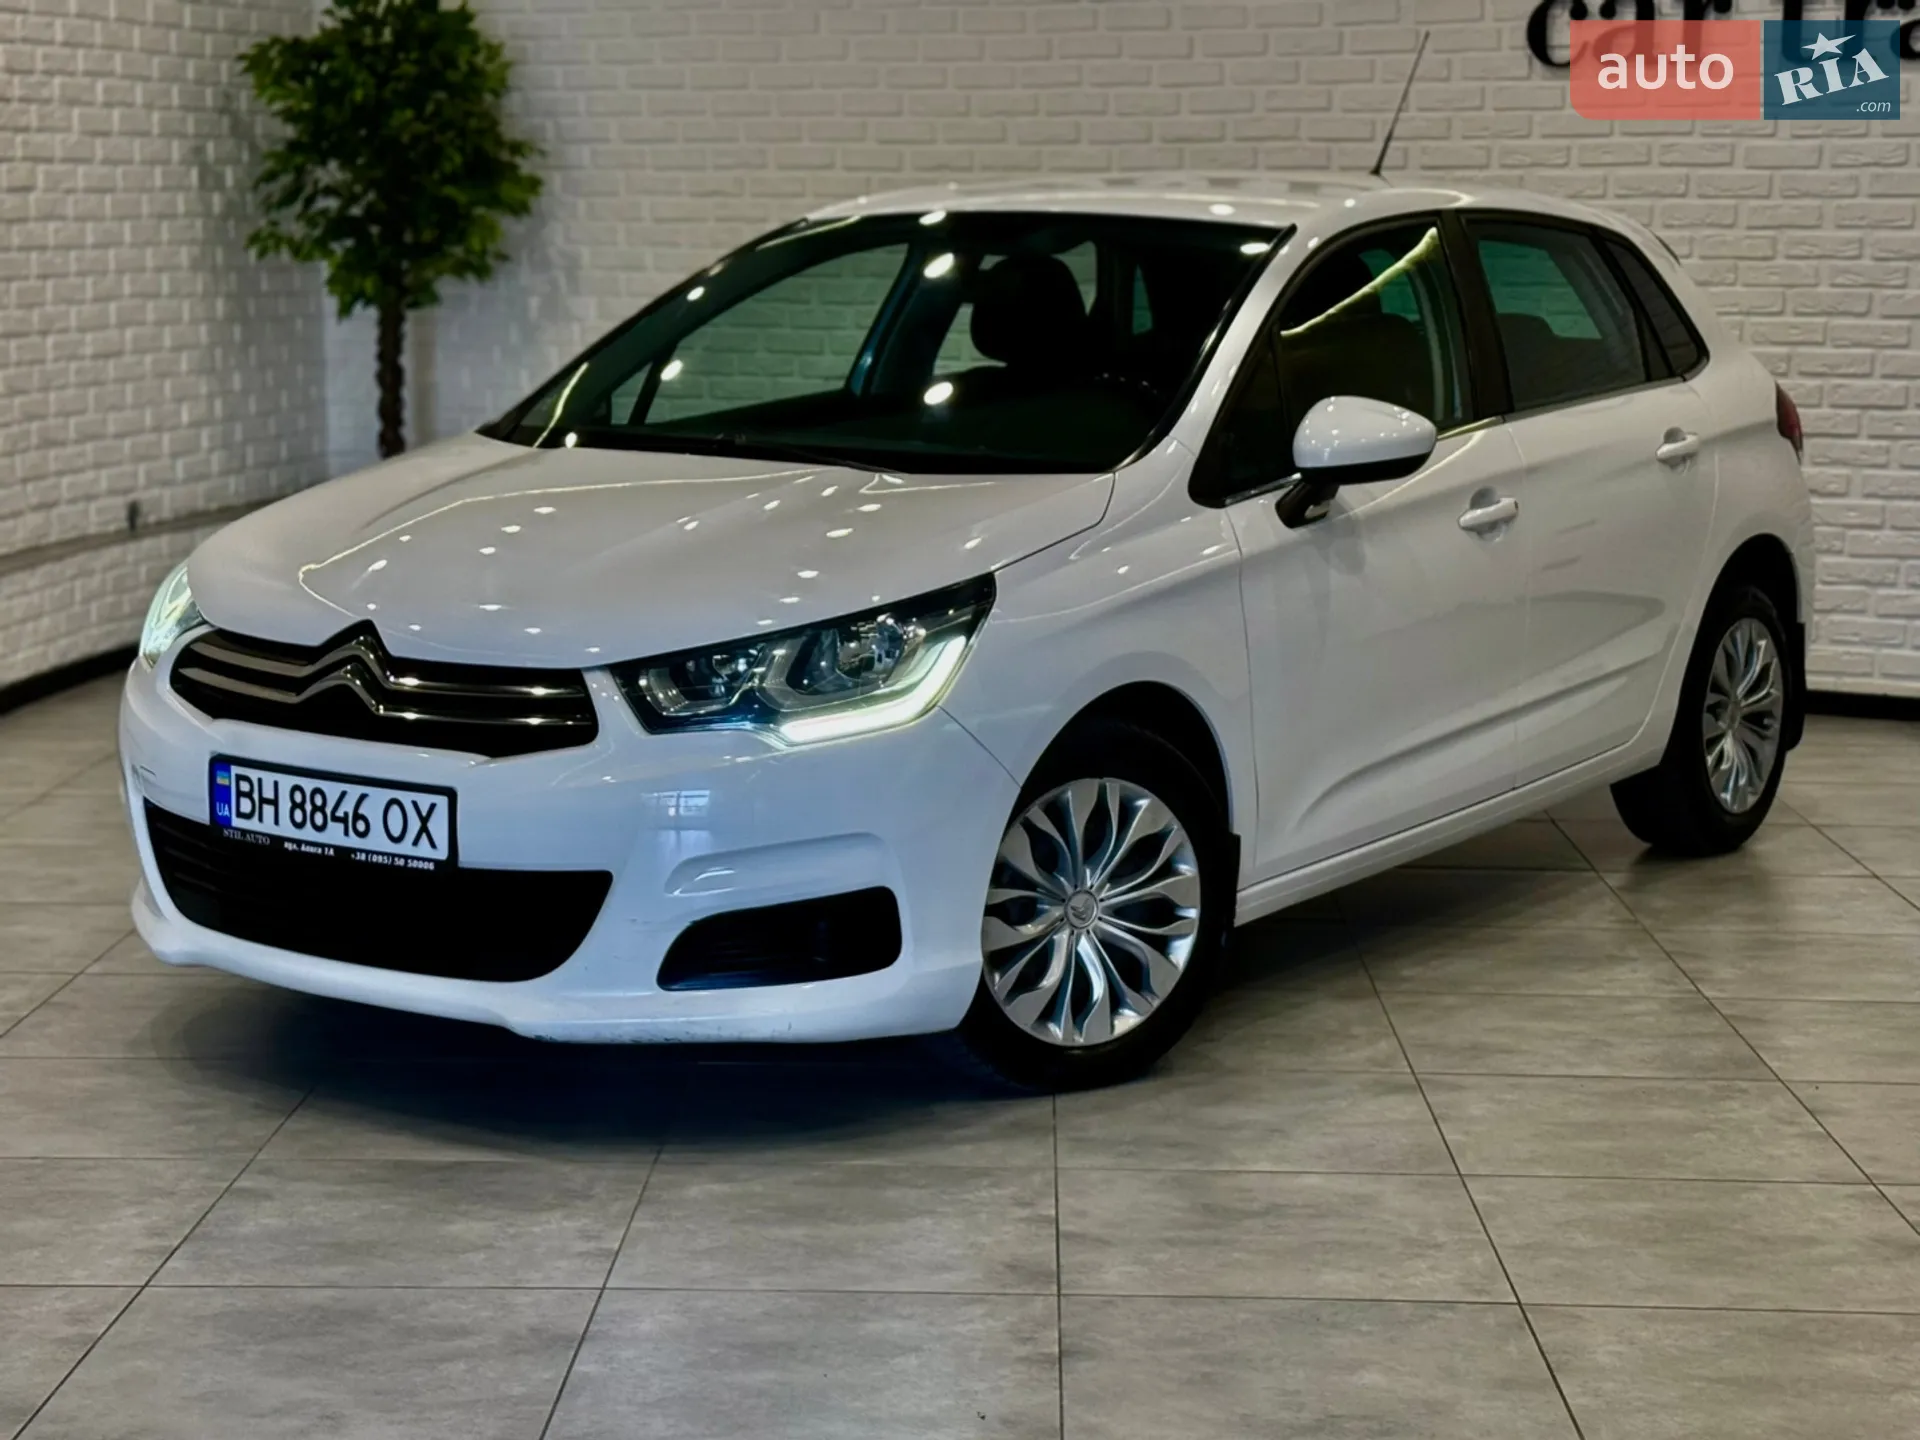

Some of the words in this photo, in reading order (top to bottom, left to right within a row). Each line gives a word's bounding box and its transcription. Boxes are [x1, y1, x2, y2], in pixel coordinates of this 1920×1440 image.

[1526, 0, 1733, 67] car
[216, 802, 231, 817] UA
[235, 773, 280, 826] BH
[289, 784, 371, 839] 8846
[382, 797, 438, 850] OX
[223, 828, 244, 841] STIL
[246, 832, 271, 846] AUTO
